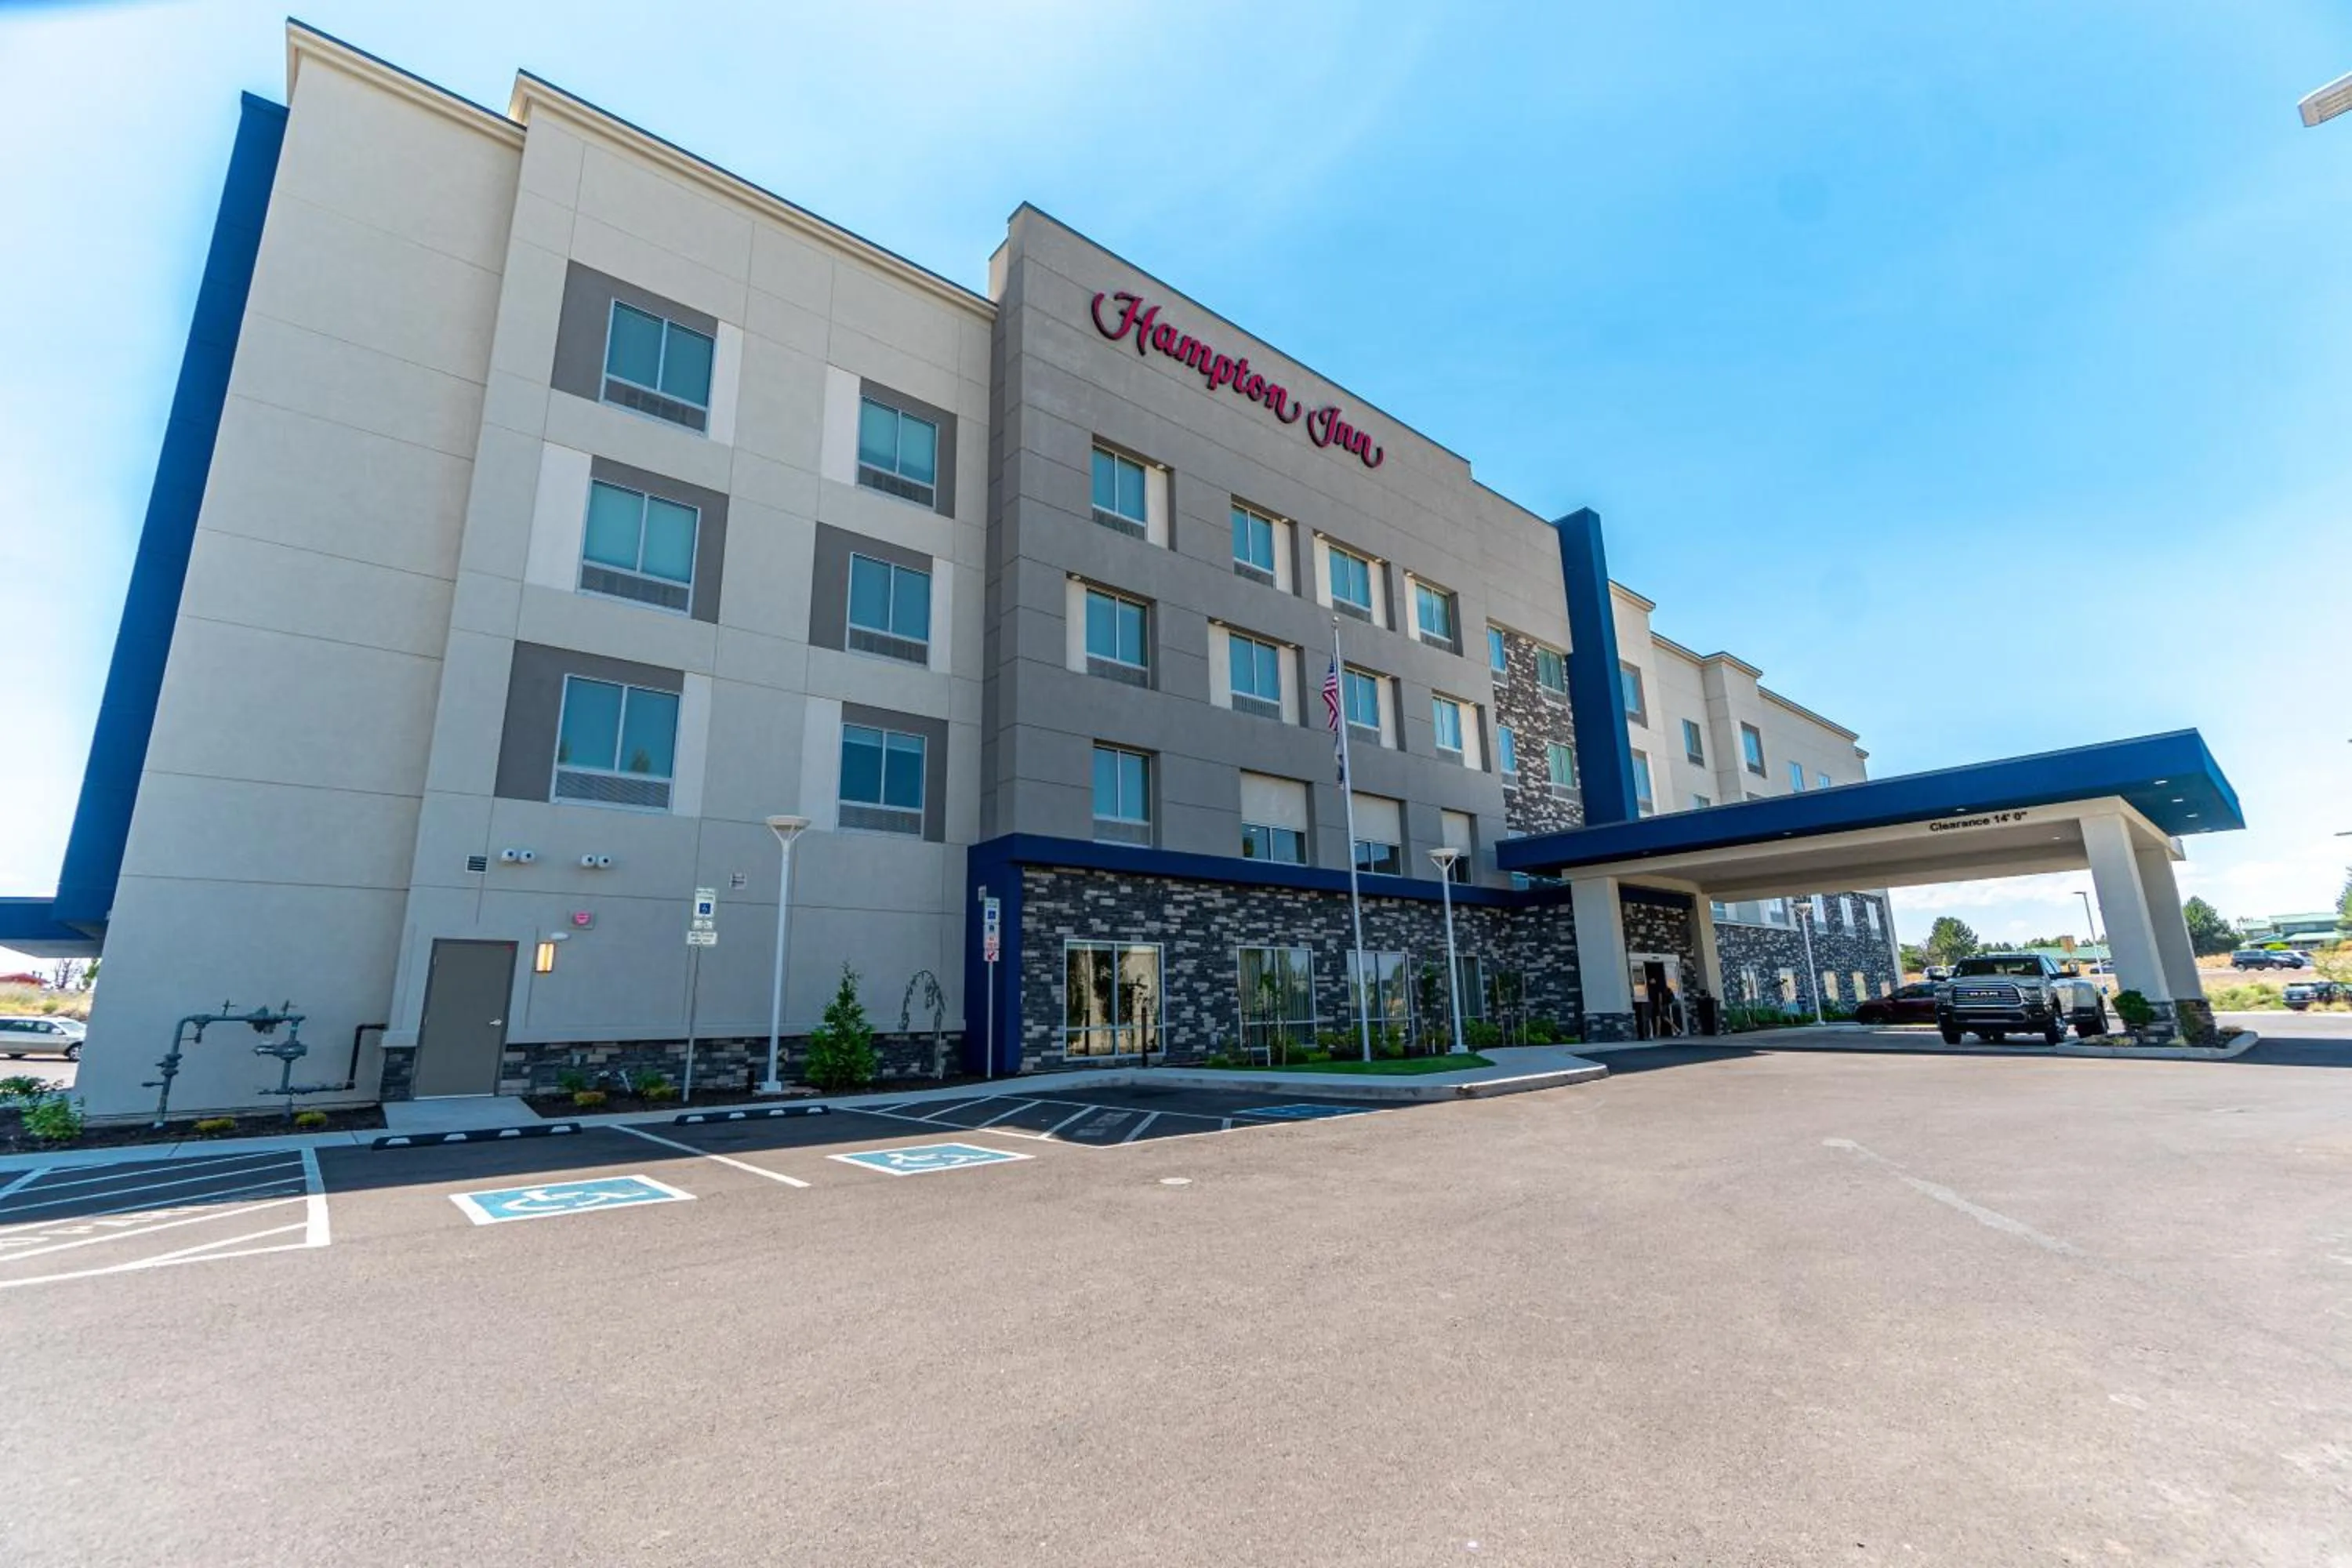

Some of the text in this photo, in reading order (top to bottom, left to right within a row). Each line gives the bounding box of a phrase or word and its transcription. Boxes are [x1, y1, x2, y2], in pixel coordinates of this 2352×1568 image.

[1091, 291, 1384, 468] Hampton Inn
[1929, 818, 1990, 832] Clearance
